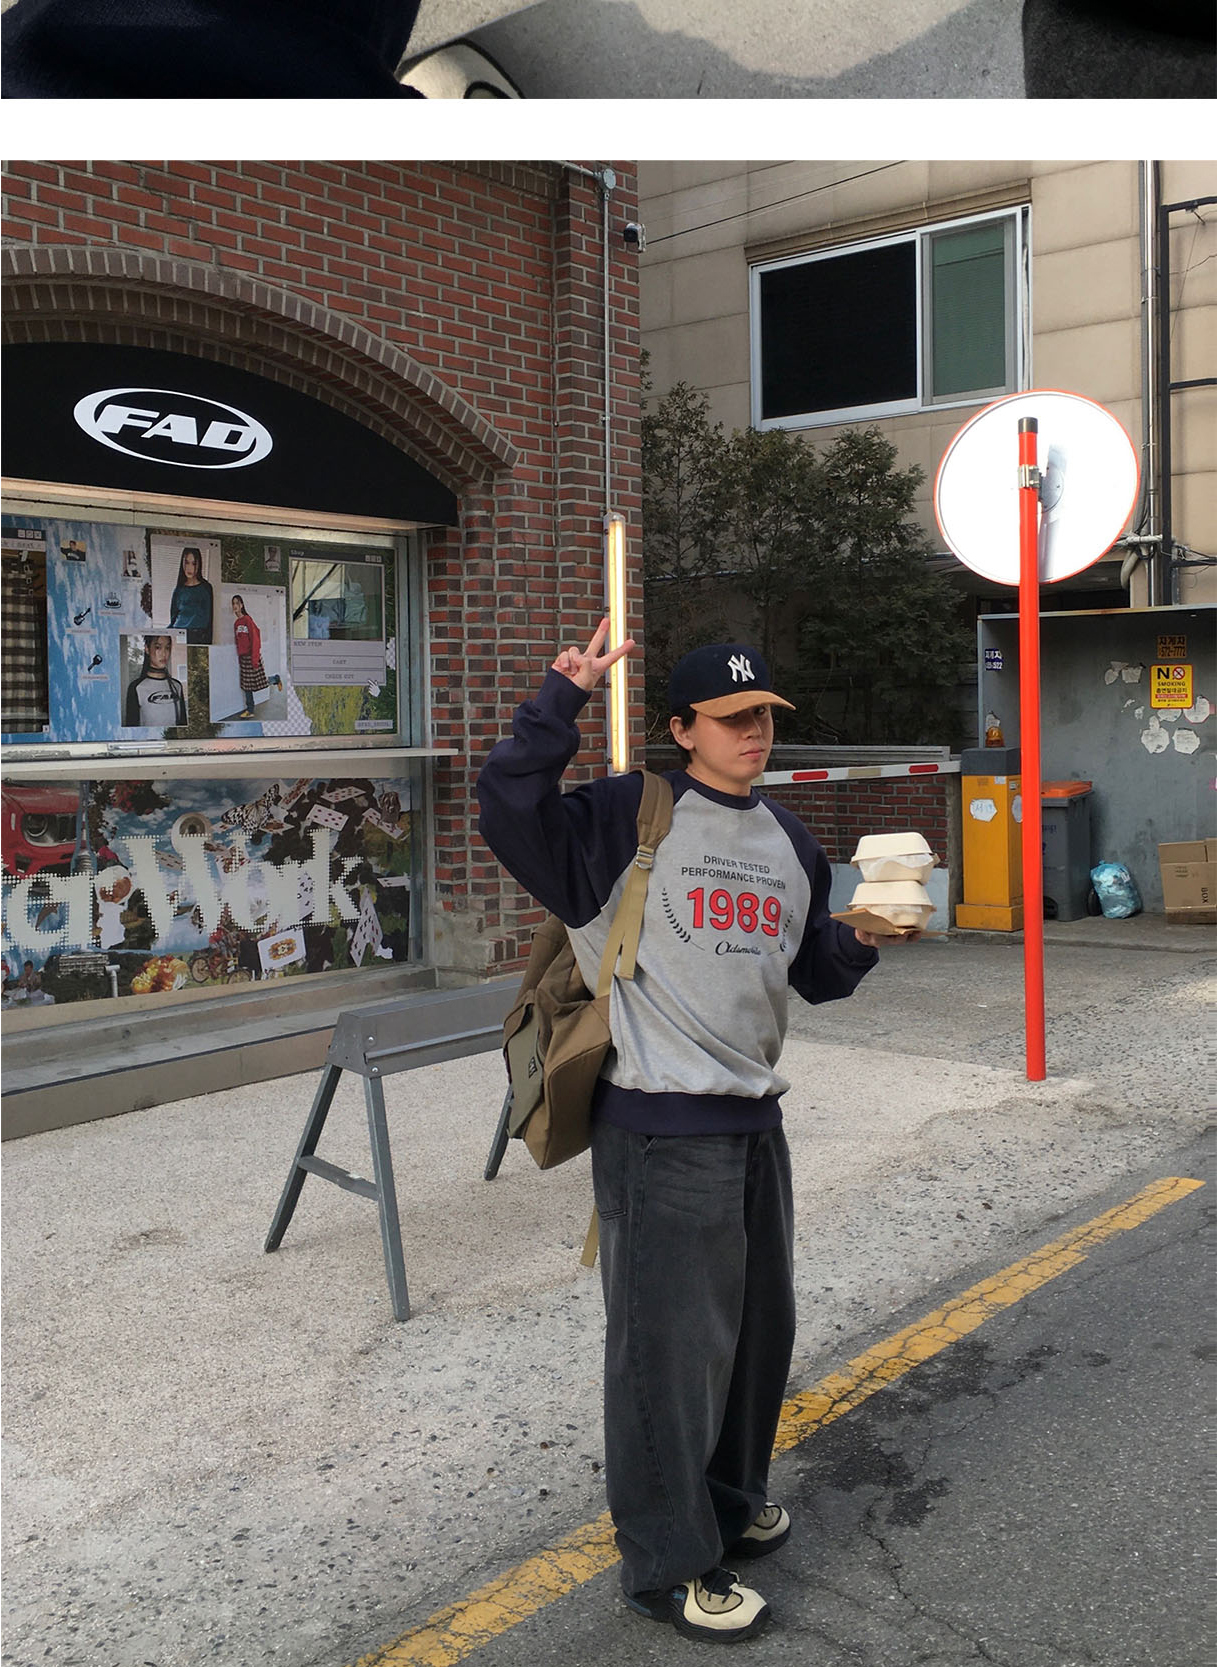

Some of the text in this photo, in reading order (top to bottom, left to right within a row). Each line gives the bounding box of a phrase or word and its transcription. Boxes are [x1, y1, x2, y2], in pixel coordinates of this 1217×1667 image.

[95, 404, 256, 452] FAD
[727, 654, 755, 682] NY
[681, 867, 786, 890] PERFORMANCE PROVEN
[703, 855, 770, 874] DRIVER TESTED
[687, 887, 782, 937] 1989
